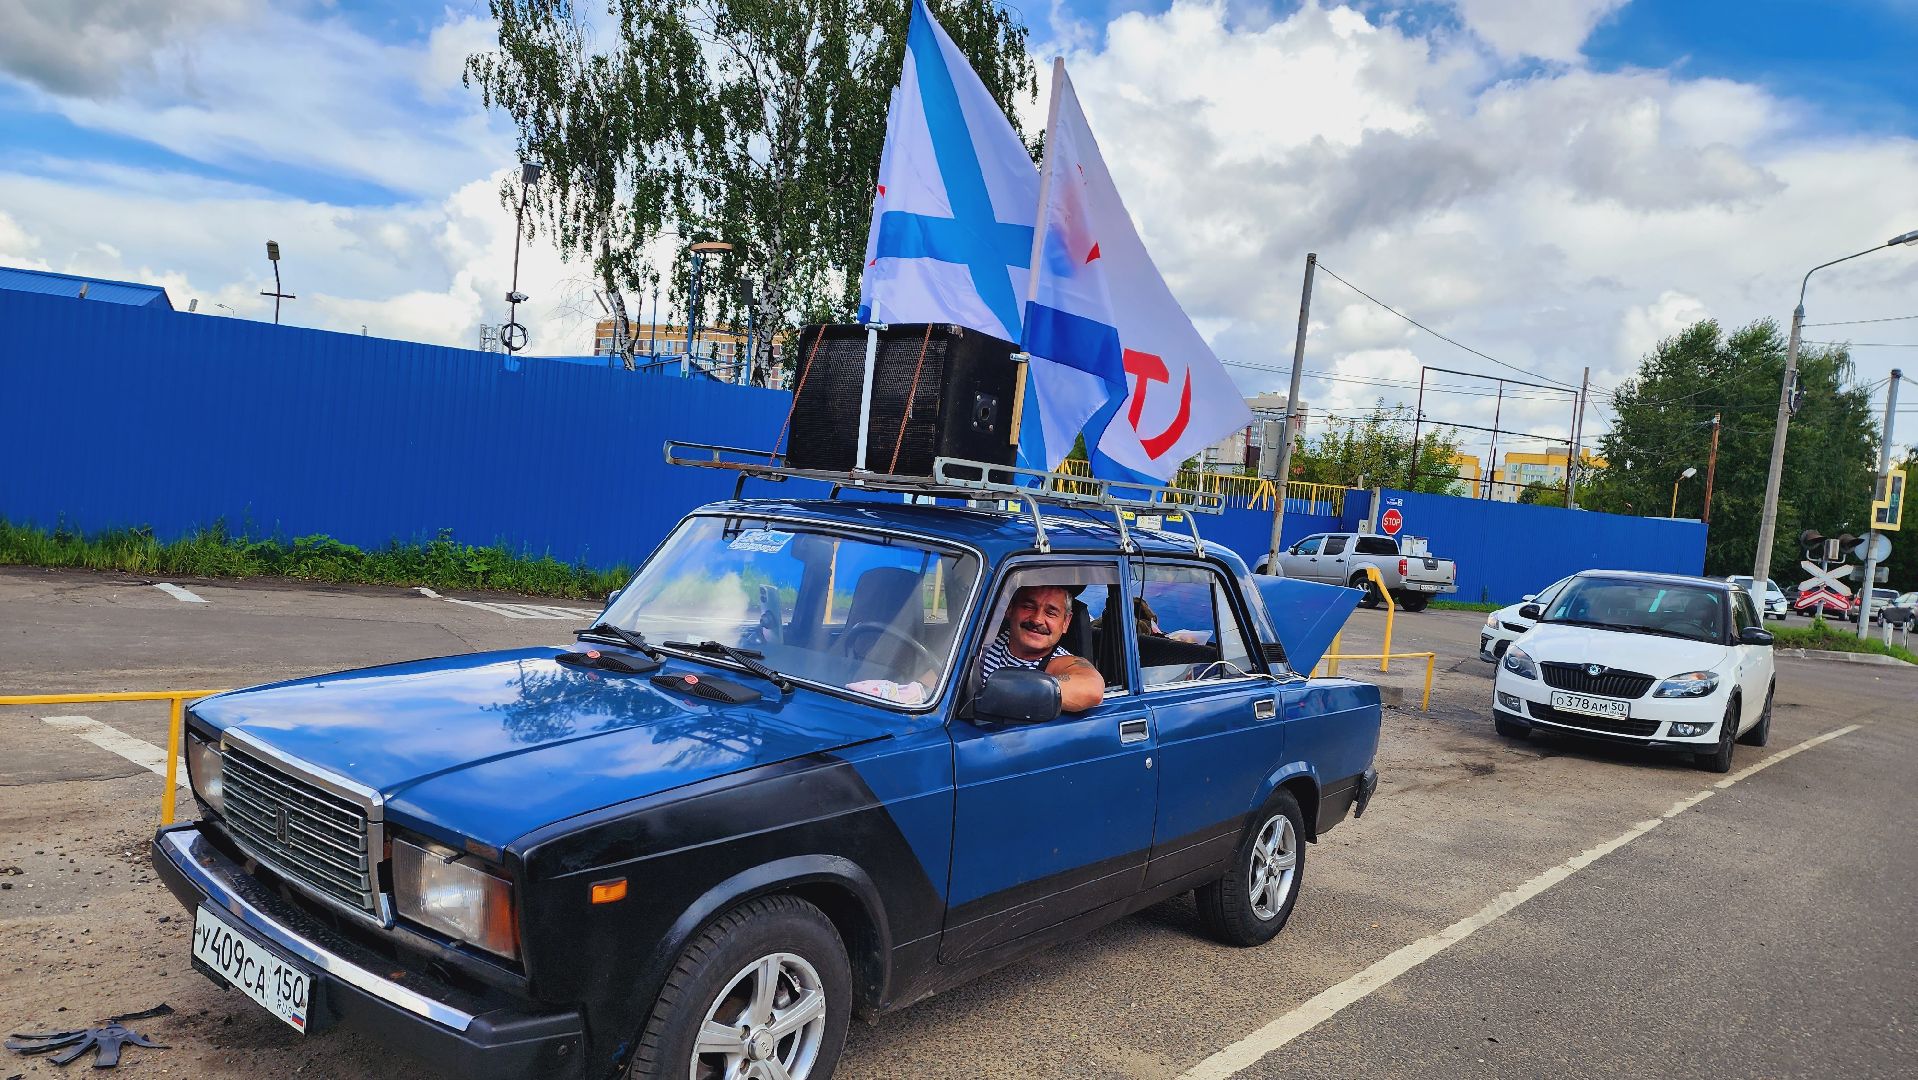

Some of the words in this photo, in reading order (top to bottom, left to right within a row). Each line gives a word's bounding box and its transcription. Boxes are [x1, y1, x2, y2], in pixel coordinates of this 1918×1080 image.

[1383, 517, 1401, 526] STOP
[273, 965, 304, 1009] 150
[276, 998, 293, 1019] RUS
